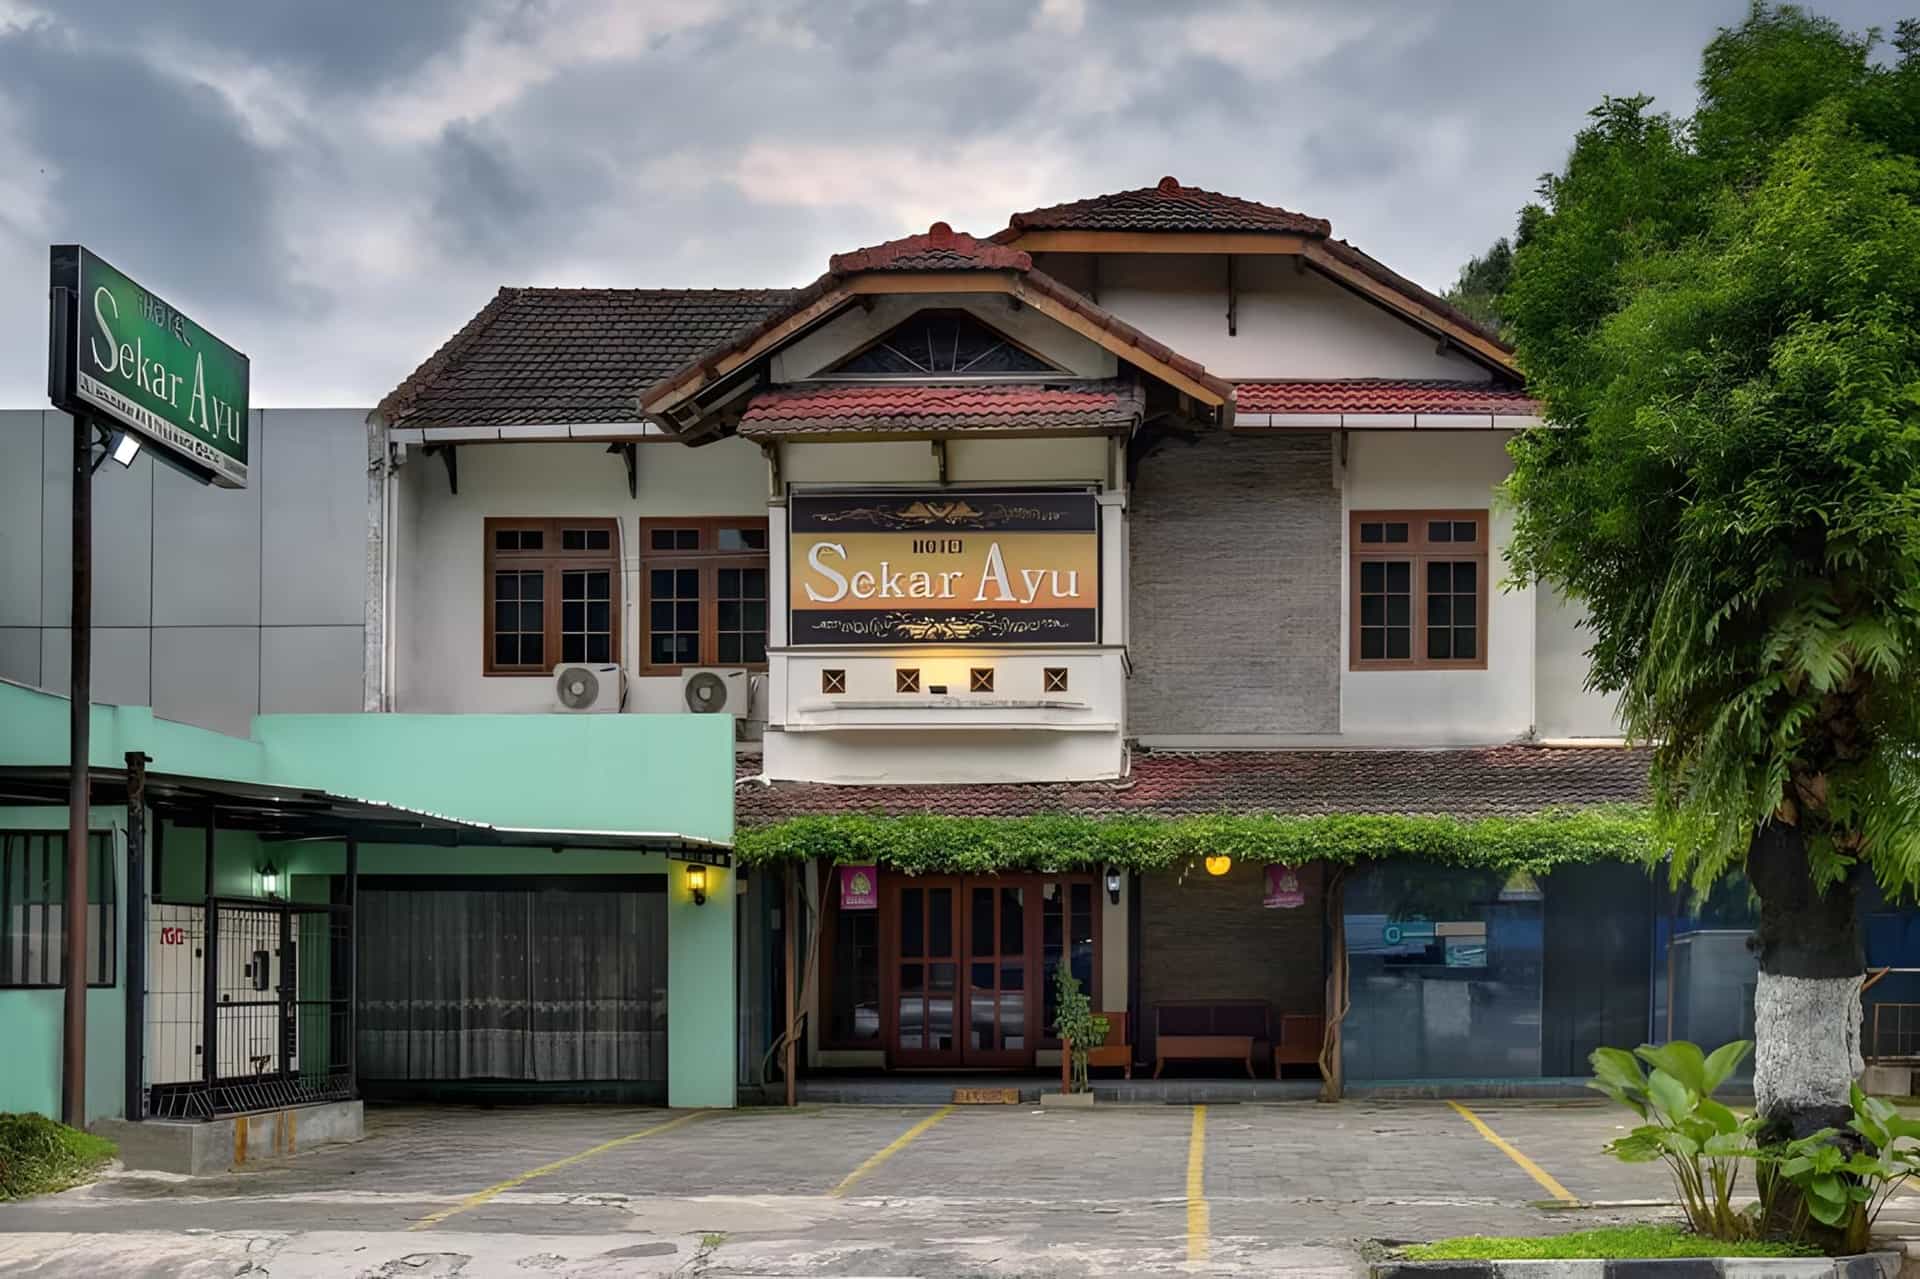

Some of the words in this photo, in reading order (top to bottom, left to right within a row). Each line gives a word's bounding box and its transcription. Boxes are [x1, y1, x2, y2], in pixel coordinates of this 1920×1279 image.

[91, 286, 183, 408] Sekar
[188, 351, 241, 444] Ayu
[804, 541, 964, 603] Sekar
[972, 541, 1080, 604] Ayu
